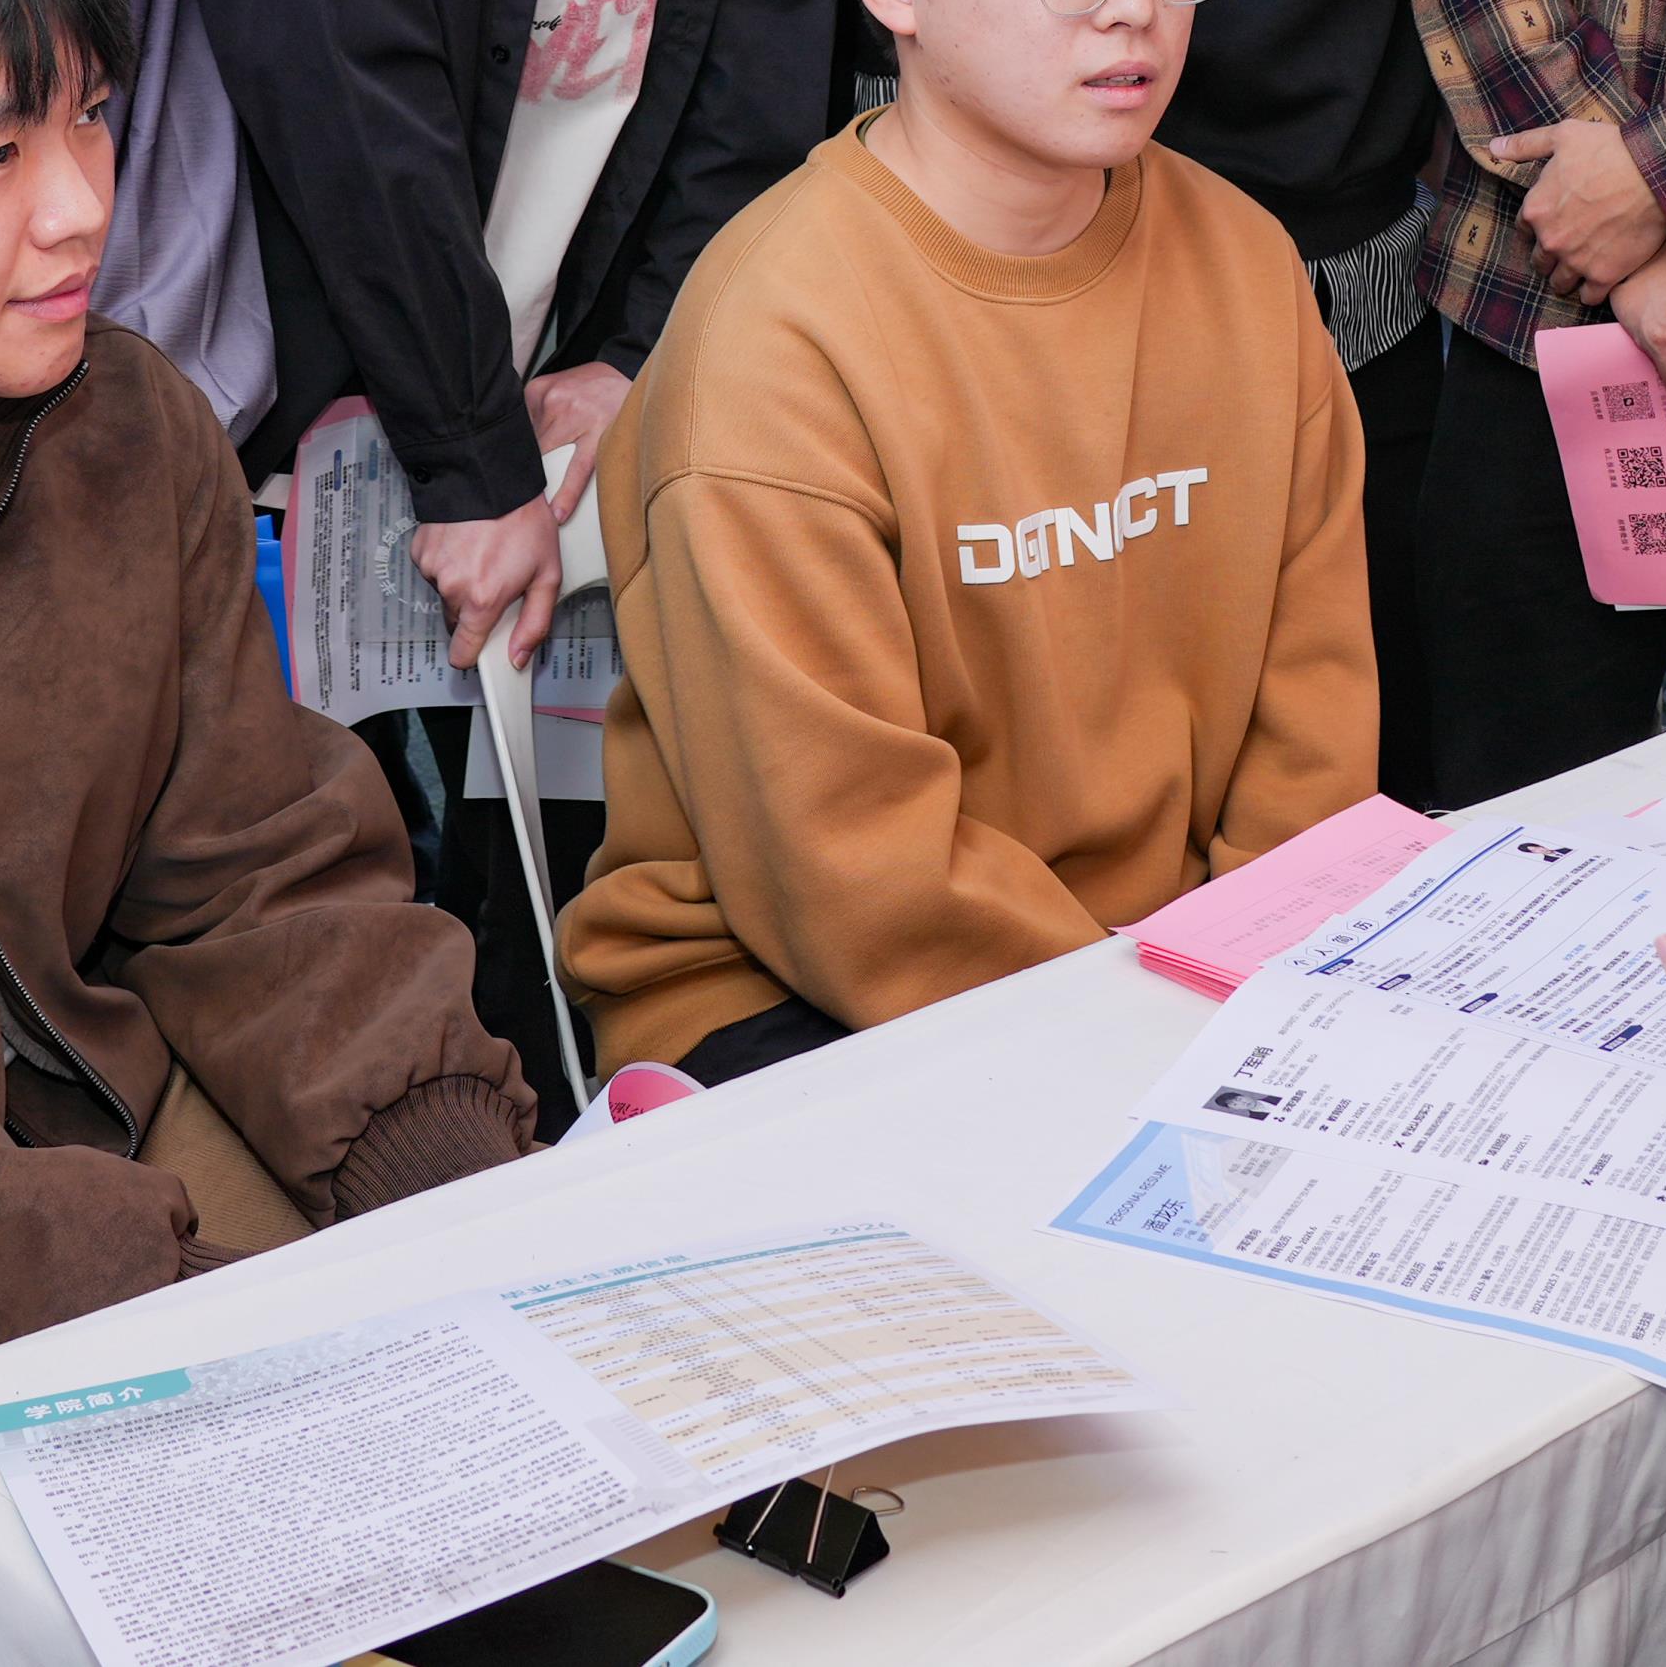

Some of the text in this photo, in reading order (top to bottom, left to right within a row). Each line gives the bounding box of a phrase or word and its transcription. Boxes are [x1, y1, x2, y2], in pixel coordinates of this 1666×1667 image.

[1103, 1163, 1173, 1226] PERSONAL RESUME
[1140, 1197, 1188, 1233] 潘龙东
[499, 1252, 691, 1301] 毕业生生源信息
[23, 1384, 146, 1422] 学院简介
